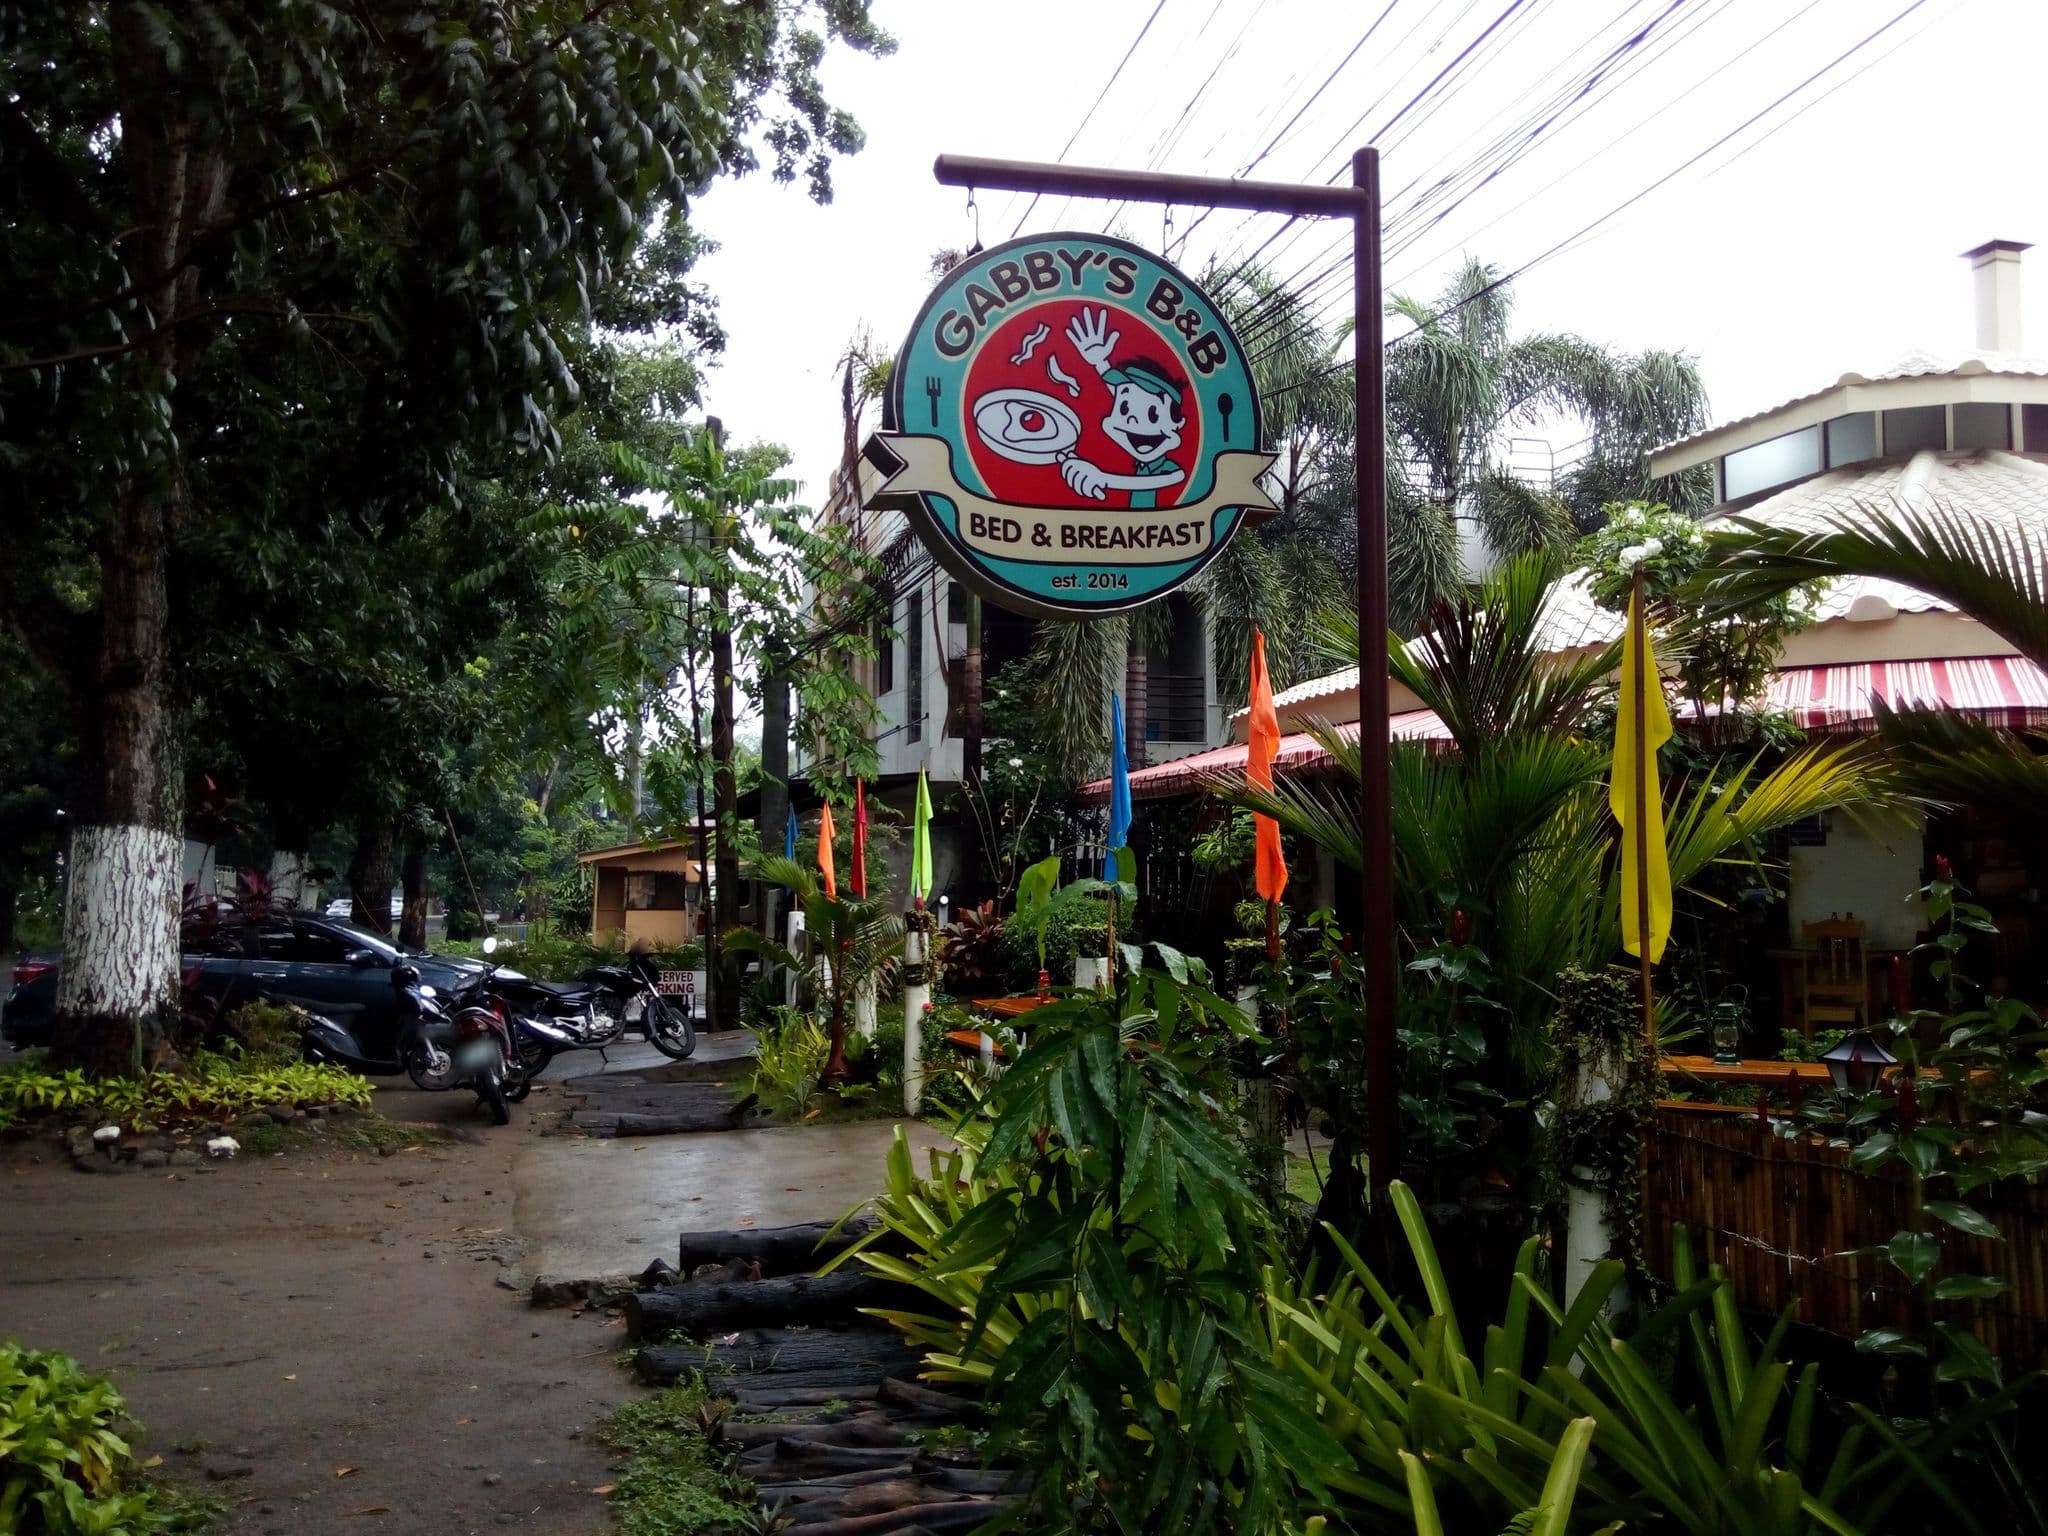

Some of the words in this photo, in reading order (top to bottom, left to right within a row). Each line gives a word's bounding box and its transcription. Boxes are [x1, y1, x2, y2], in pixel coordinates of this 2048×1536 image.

[934, 249, 1138, 356] GABBY'S
[1146, 277, 1227, 374] B&B
[970, 512, 1023, 543] BED
[1031, 523, 1052, 547] &
[1061, 520, 1204, 549] BREAKFAST
[1051, 572, 1082, 589] est.
[1088, 572, 1129, 589] 2014
[658, 971, 694, 982] SERVED
[656, 983, 695, 993] RKING
